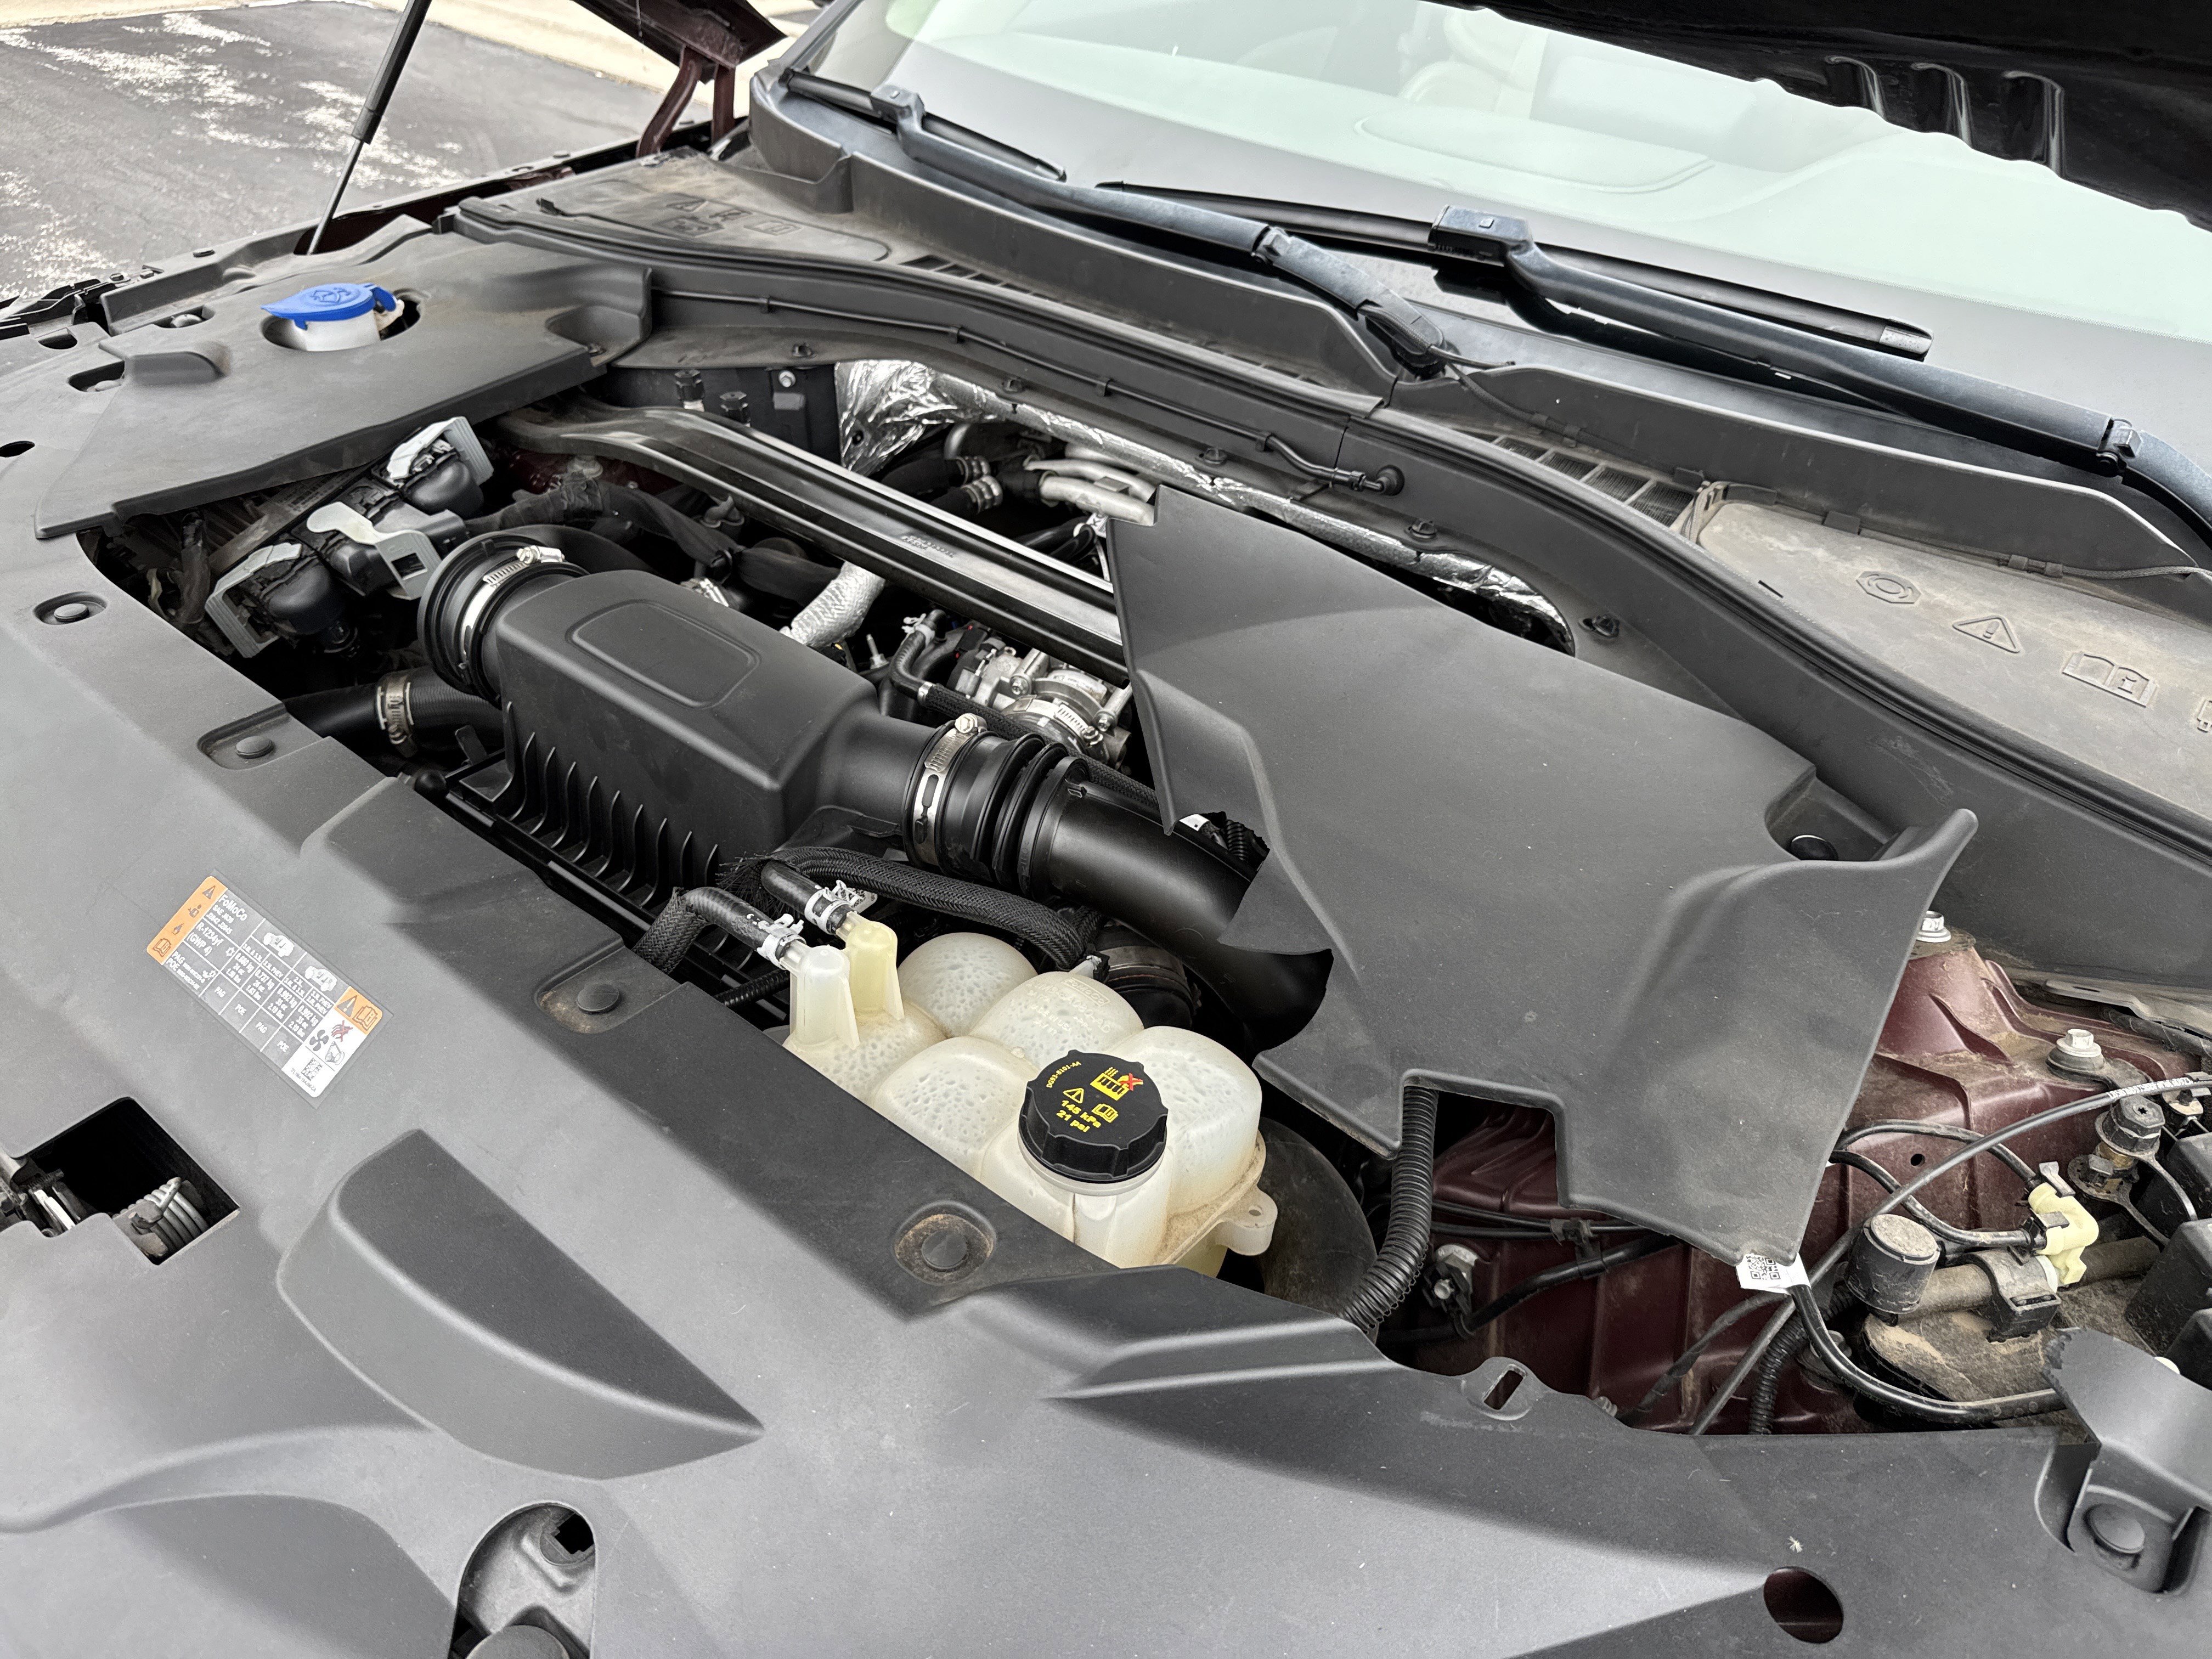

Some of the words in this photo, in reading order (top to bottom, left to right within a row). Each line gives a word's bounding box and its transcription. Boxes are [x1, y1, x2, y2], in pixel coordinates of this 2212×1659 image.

[212, 905, 224, 915] SAE
[218, 894, 247, 921] FoMoCo
[196, 921, 224, 946] R-1234yf
[186, 932, 206, 948] (GWP
[204, 946, 212, 956] 4)
[171, 951, 185, 964] PAG
[166, 957, 180, 971] POE
[246, 962, 254, 973] kg
[270, 967, 283, 978] PHEV
[233, 974, 241, 983] lbs
[252, 979, 261, 988] 26
[255, 969, 269, 983] 0.737
[266, 979, 274, 990] kg
[214, 986, 225, 997] PAG
[253, 991, 261, 1000] lbs
[289, 997, 297, 1008] kg
[314, 1002, 328, 1014] PHEV
[319, 997, 332, 1008] PHEV
[234, 1003, 246, 1015] POE
[275, 1009, 284, 1019] lbs
[296, 1015, 304, 1024] 35
[310, 1015, 319, 1026] kg
[255, 1022, 267, 1033] PAG
[296, 1028, 305, 1037] lbs
[276, 1040, 289, 1052] POE
[1046, 1061, 1081, 1088] DG93-8101-AA
[1062, 1100, 1081, 1114] 145
[1080, 1112, 1101, 1128] kPa
[1057, 1110, 1071, 1121] 21
[1070, 1120, 1091, 1132] psi
